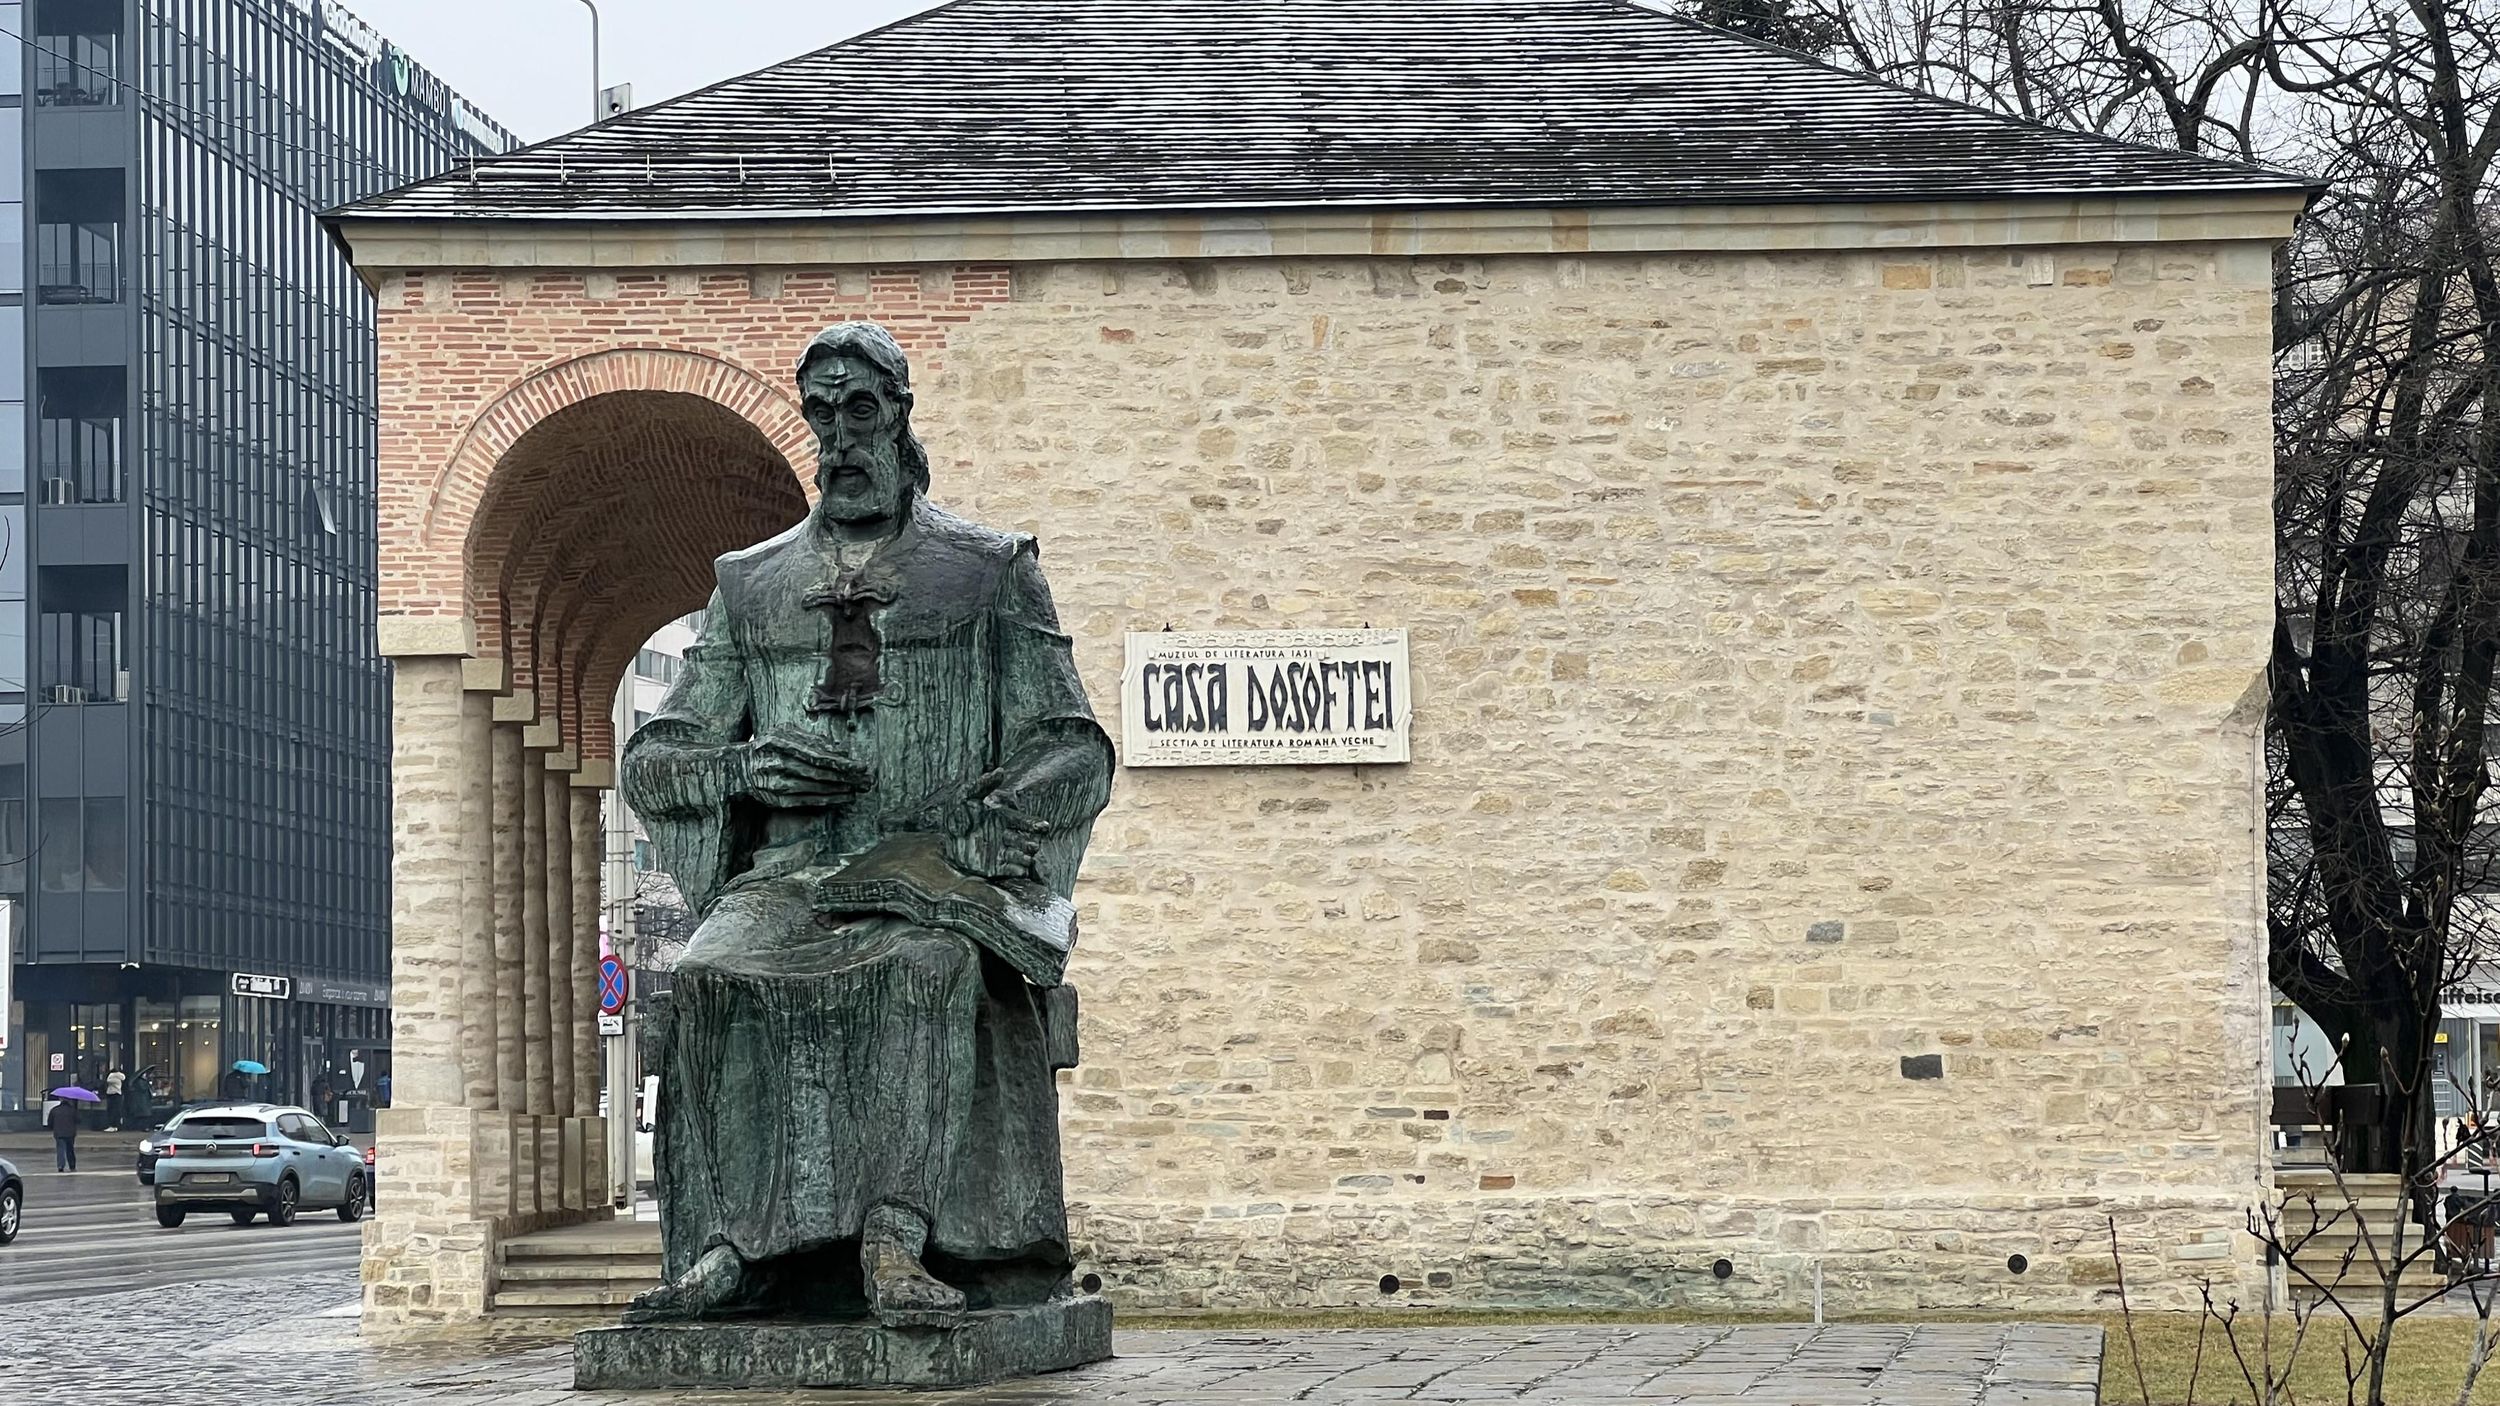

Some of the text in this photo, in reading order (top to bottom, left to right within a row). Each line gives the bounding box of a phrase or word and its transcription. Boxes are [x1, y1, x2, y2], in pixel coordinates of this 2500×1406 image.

[410, 70, 446, 118] MAMBO
[1158, 650, 1312, 659] MUZEUL DE LITERATURA IASI
[1247, 660, 1395, 733] DOSOFTEI
[1160, 737, 1375, 748] SECTIA DE LITERATURA ROMANA VECHE
